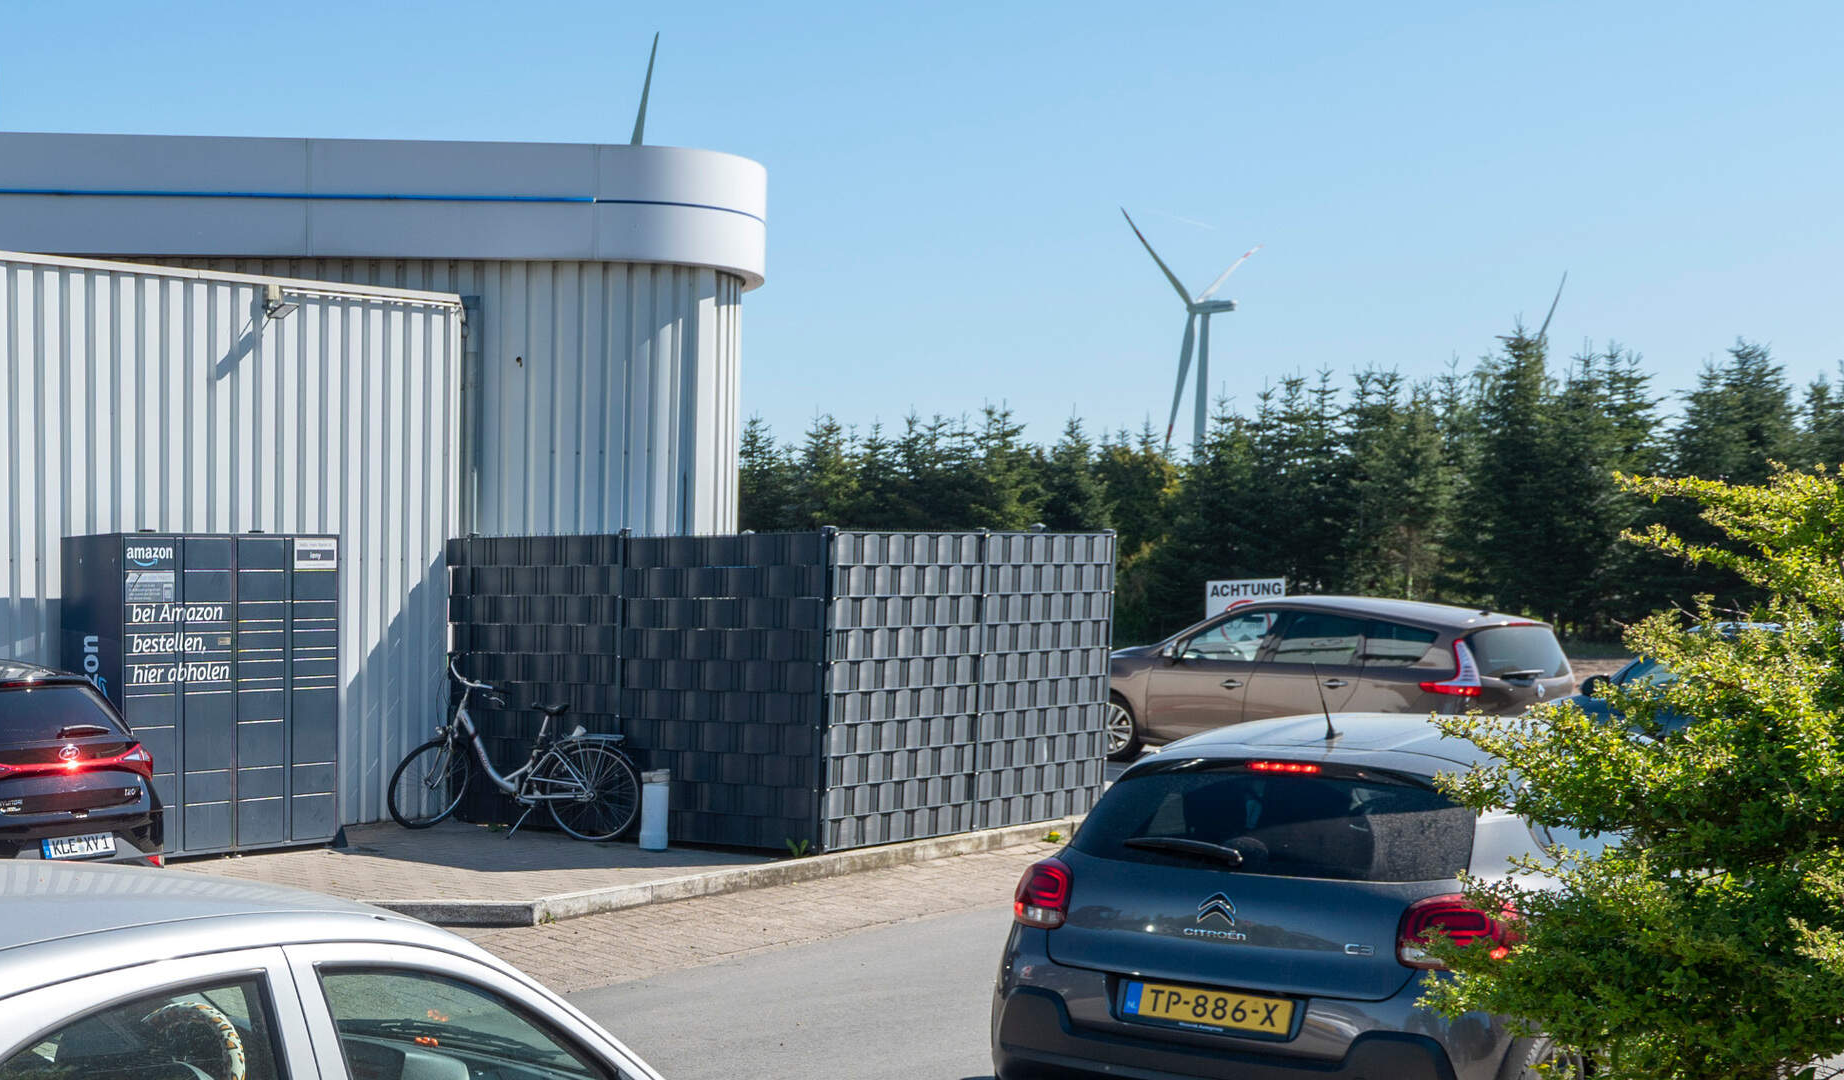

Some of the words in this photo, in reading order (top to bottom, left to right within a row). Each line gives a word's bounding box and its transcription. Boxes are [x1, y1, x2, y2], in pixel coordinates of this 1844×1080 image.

[126, 546, 173, 560] amazon
[1210, 582, 1282, 597] ACHTUNG
[132, 604, 156, 622] bei
[159, 604, 223, 622] Amazon
[132, 633, 207, 655] bestellen,
[133, 664, 164, 683] hier
[168, 662, 229, 682] abholen
[52, 839, 77, 855] KLE
[1183, 927, 1246, 941] CITROËN
[1344, 943, 1374, 956] C3
[1150, 988, 1280, 1028] TP-886-X
